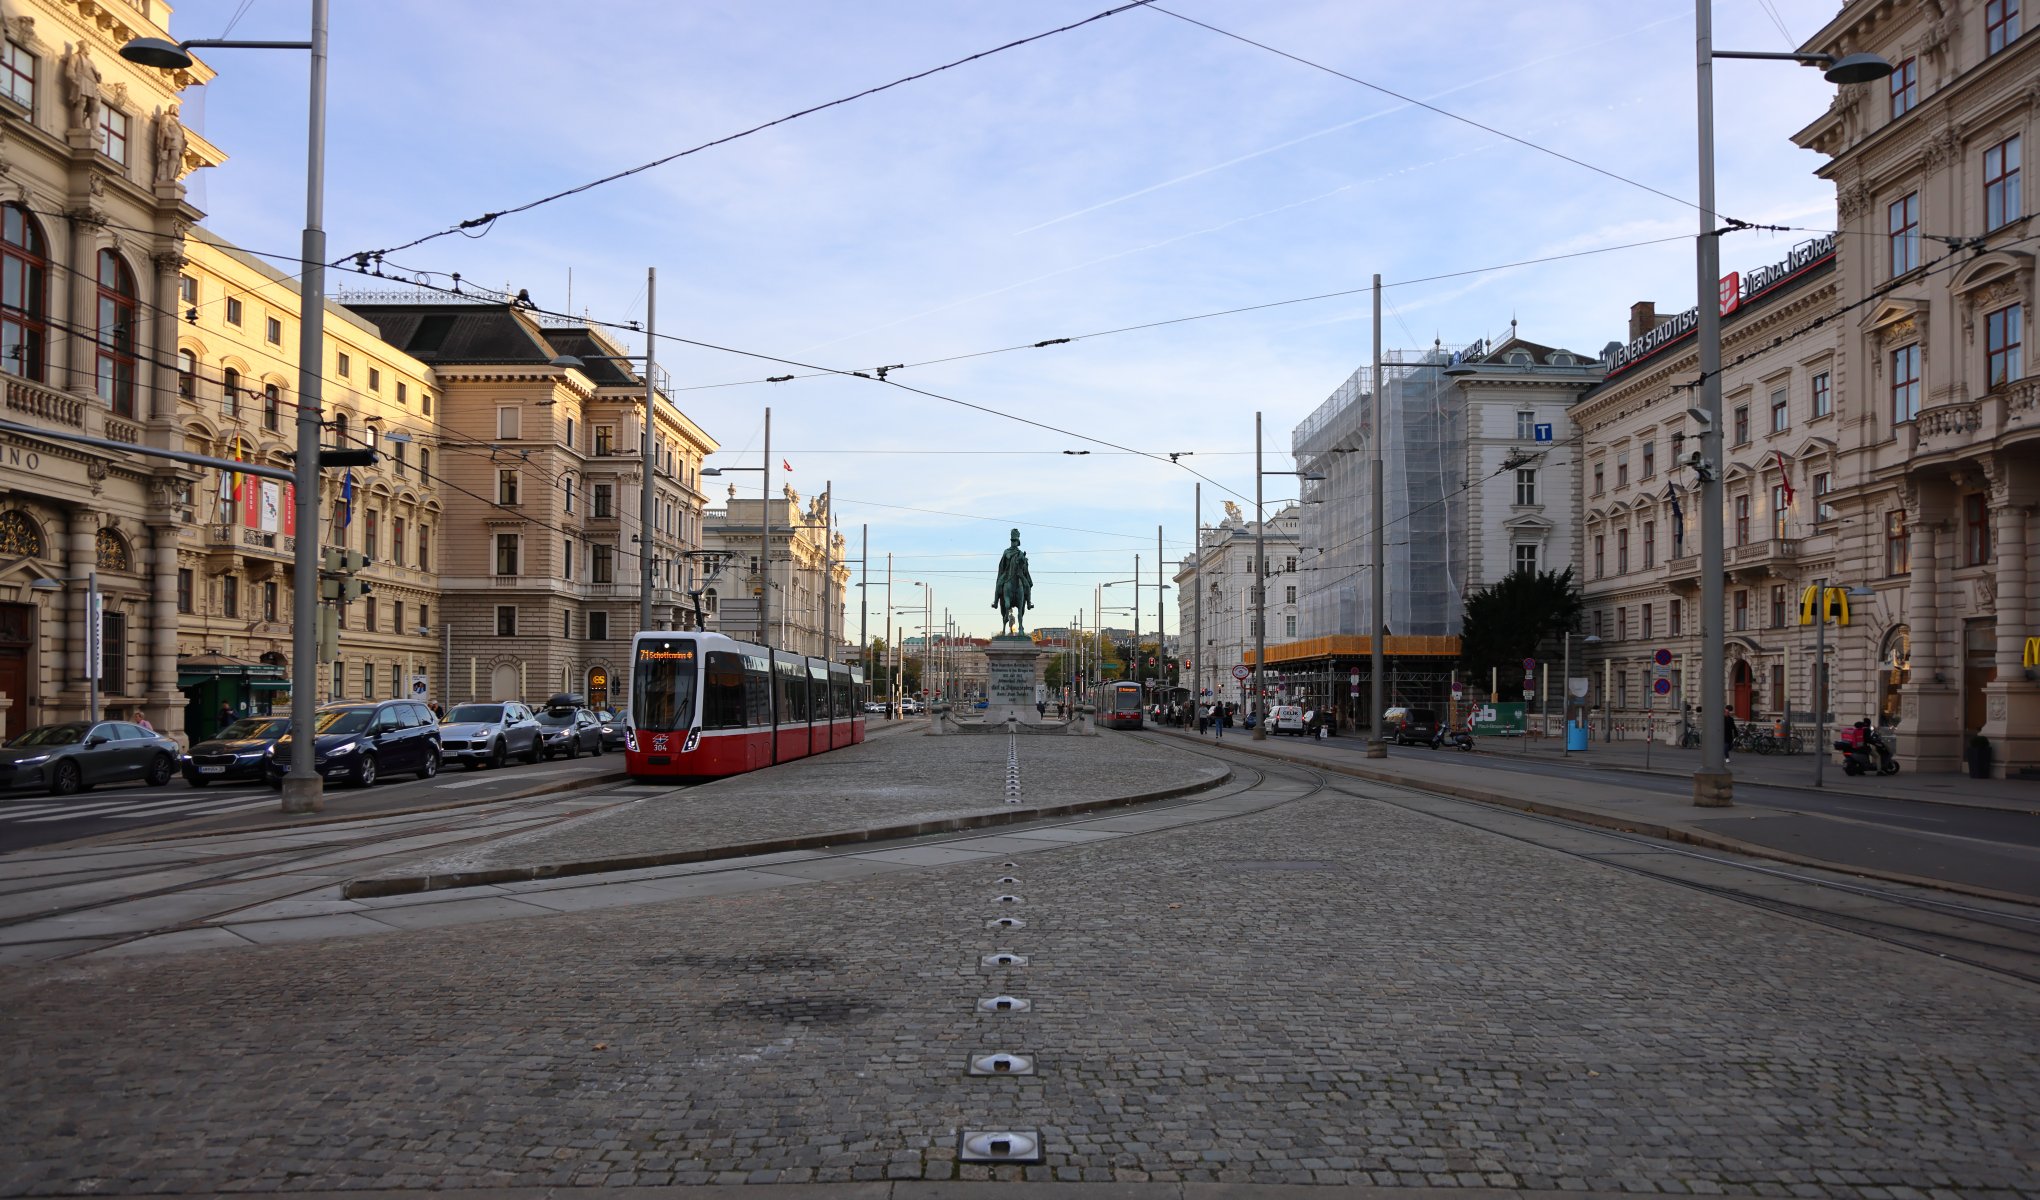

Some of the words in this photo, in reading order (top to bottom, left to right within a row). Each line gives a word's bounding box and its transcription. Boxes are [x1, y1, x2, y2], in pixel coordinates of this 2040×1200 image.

[1743, 261, 1784, 295] VIENNA
[1605, 335, 1644, 372] WIENER
[1645, 306, 1699, 351] STÄDTISC
[640, 649, 649, 661] 71
[653, 744, 667, 752] 304
